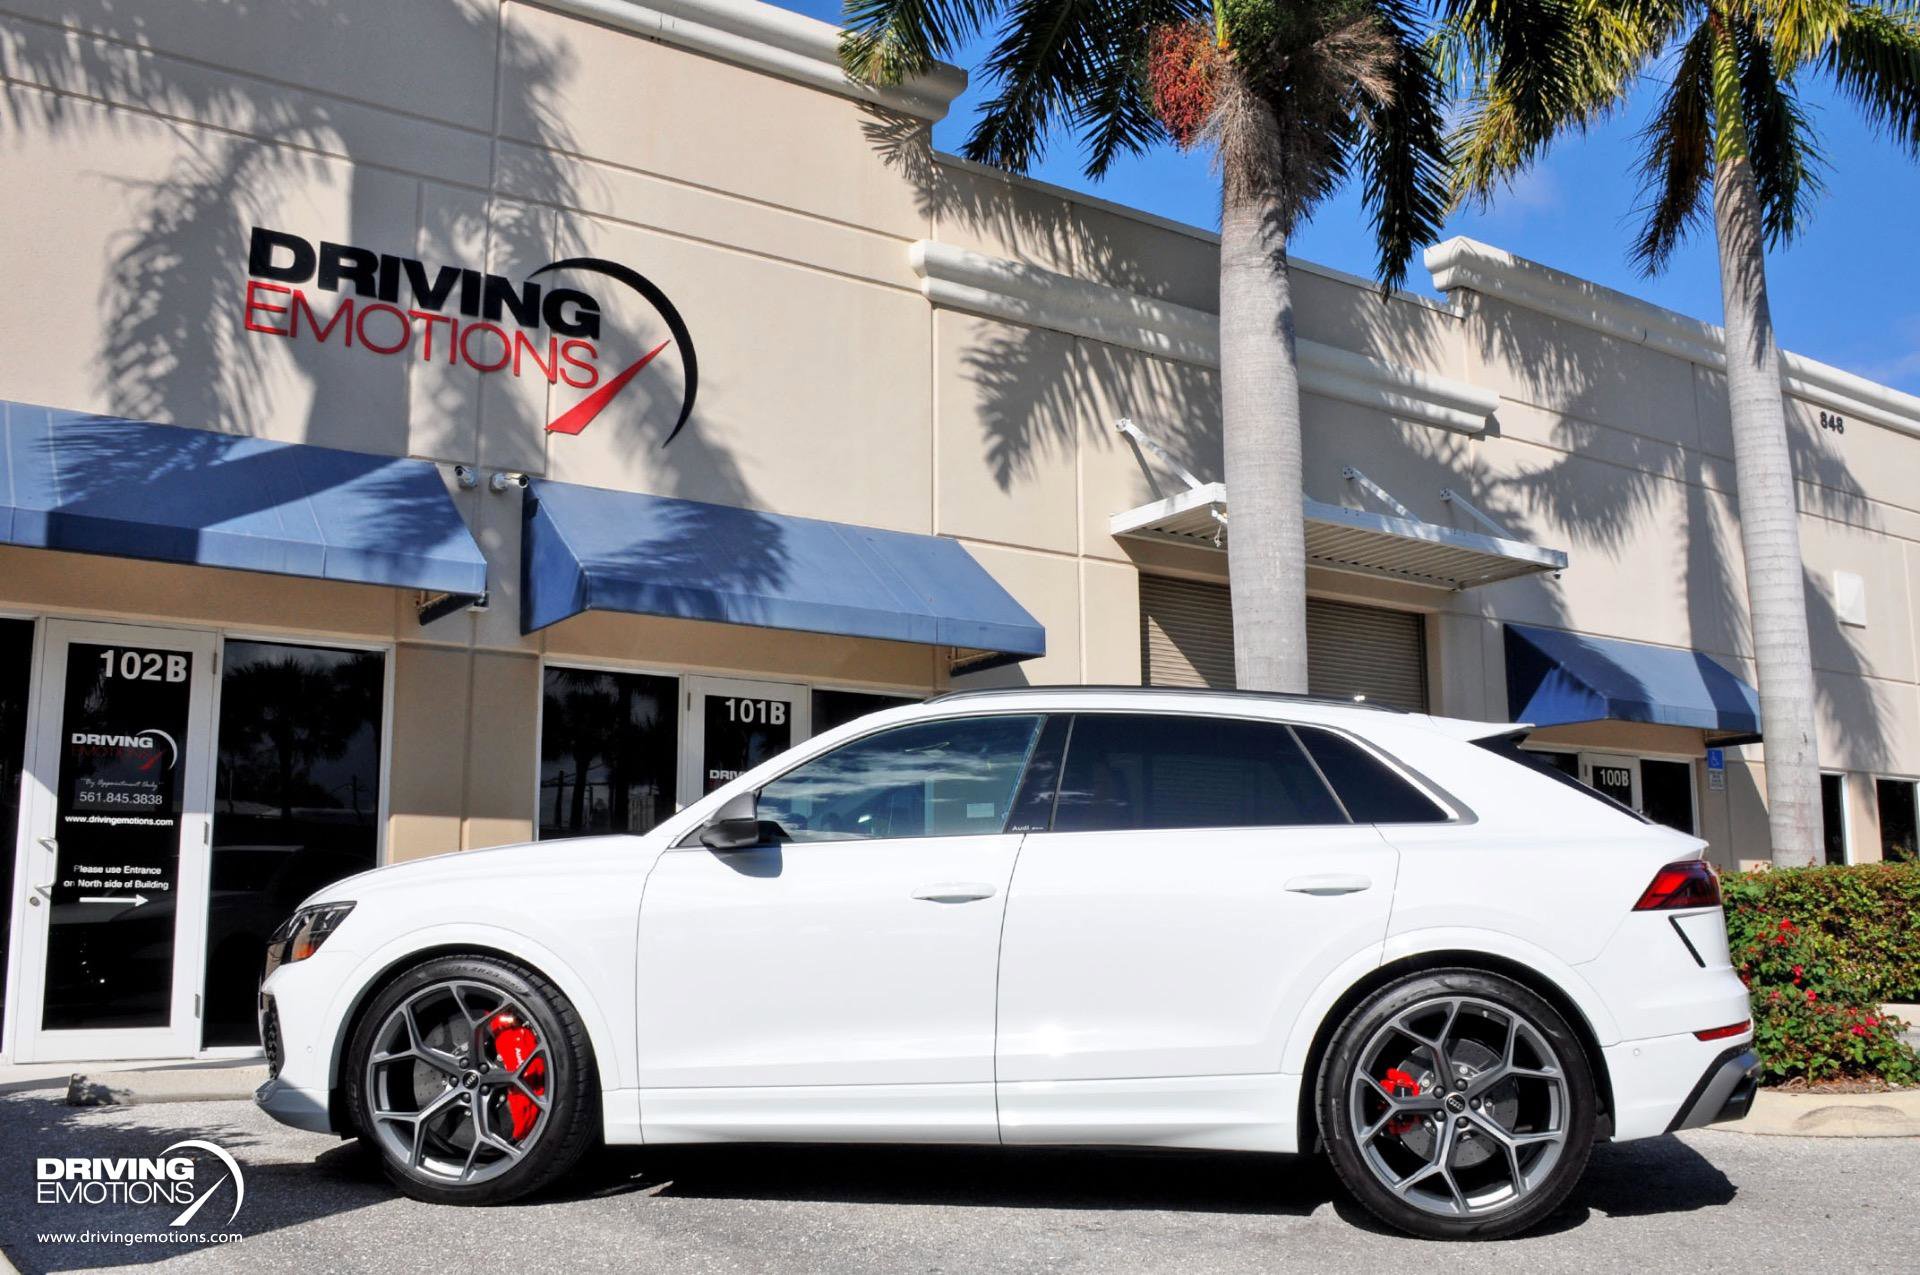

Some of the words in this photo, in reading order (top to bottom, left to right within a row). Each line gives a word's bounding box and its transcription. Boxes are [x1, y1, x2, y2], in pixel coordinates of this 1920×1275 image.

[249, 226, 600, 340] DRIVING
[244, 280, 599, 389] EMOTIONS
[1820, 411, 1844, 434] 848
[100, 650, 187, 682] 102B
[725, 699, 785, 725] 101B
[72, 733, 153, 748] DRIVING
[1600, 769, 1629, 786] 100B
[80, 791, 163, 805] 561.845.3838
[65, 815, 174, 826] www.drivingemotions.com
[73, 864, 103, 873] Please
[105, 866, 121, 874] use
[123, 865, 161, 874] Entrance
[63, 880, 75, 888] on
[78, 879, 102, 888] North
[104, 880, 122, 888] side
[124, 880, 133, 888] of
[134, 880, 169, 891] Building
